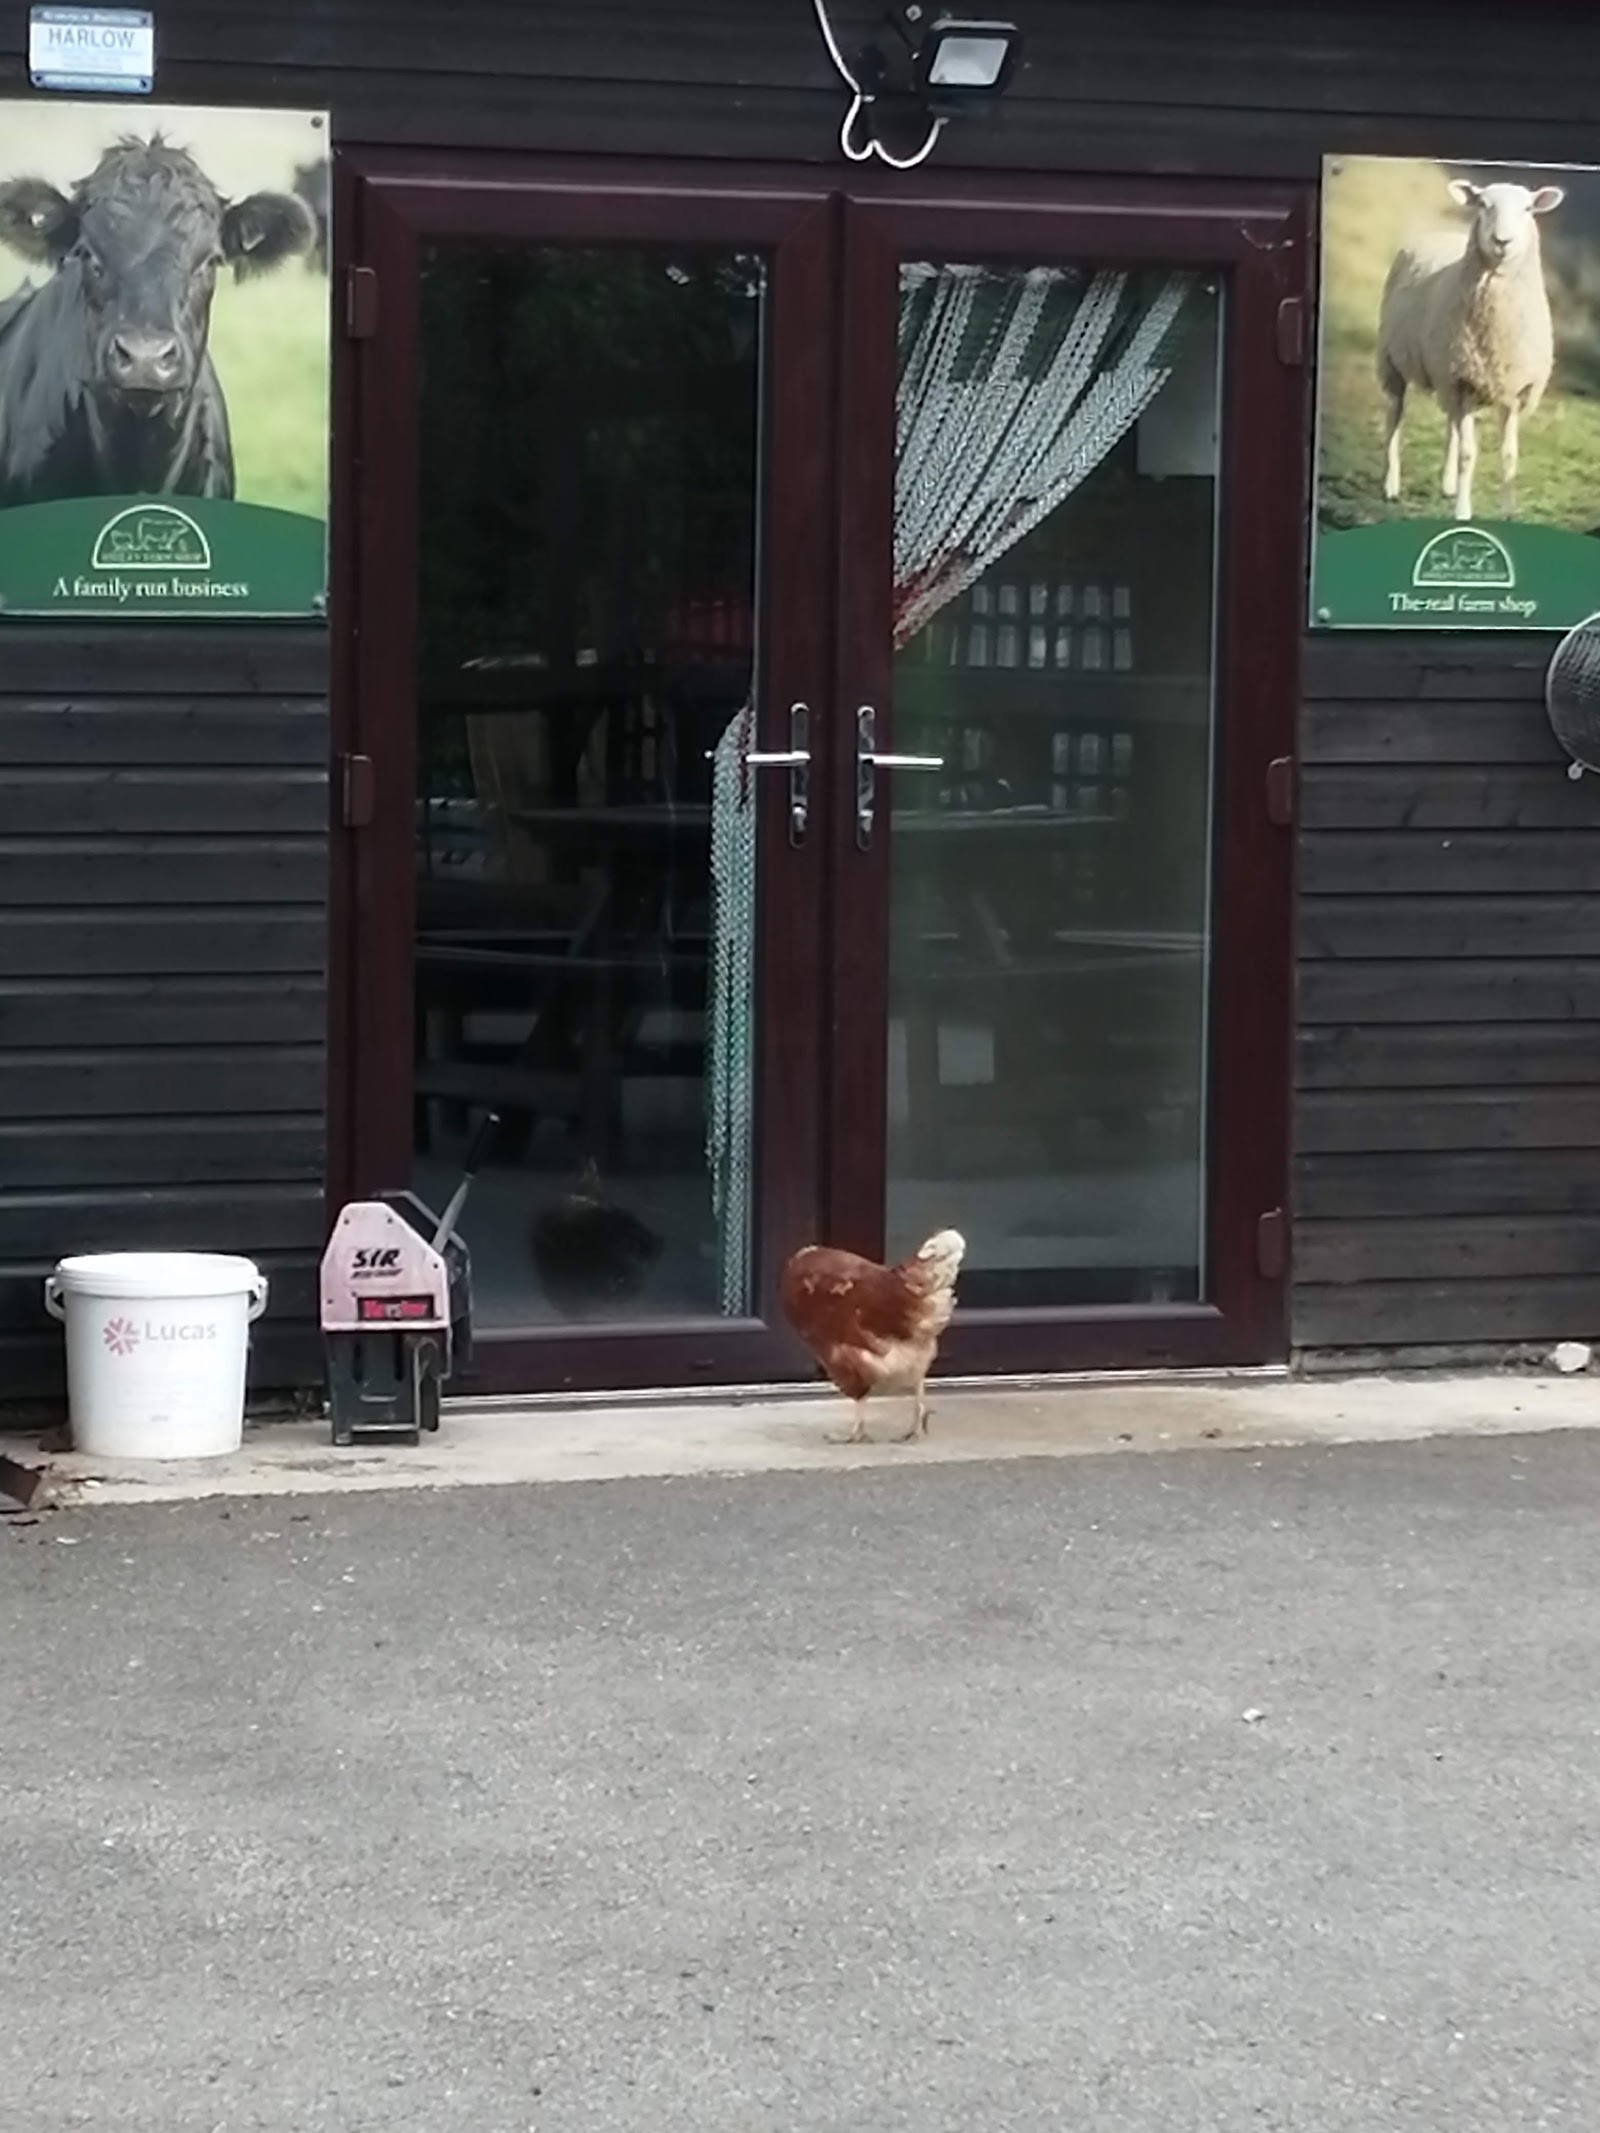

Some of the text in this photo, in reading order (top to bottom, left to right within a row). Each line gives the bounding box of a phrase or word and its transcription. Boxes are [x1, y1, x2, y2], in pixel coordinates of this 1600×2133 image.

[48, 27, 135, 48] HARLOW
[53, 576, 249, 603] A family run business
[1388, 593, 1537, 618] The real farm shop
[352, 1249, 401, 1268] SIR
[145, 1322, 217, 1341] Lucas
